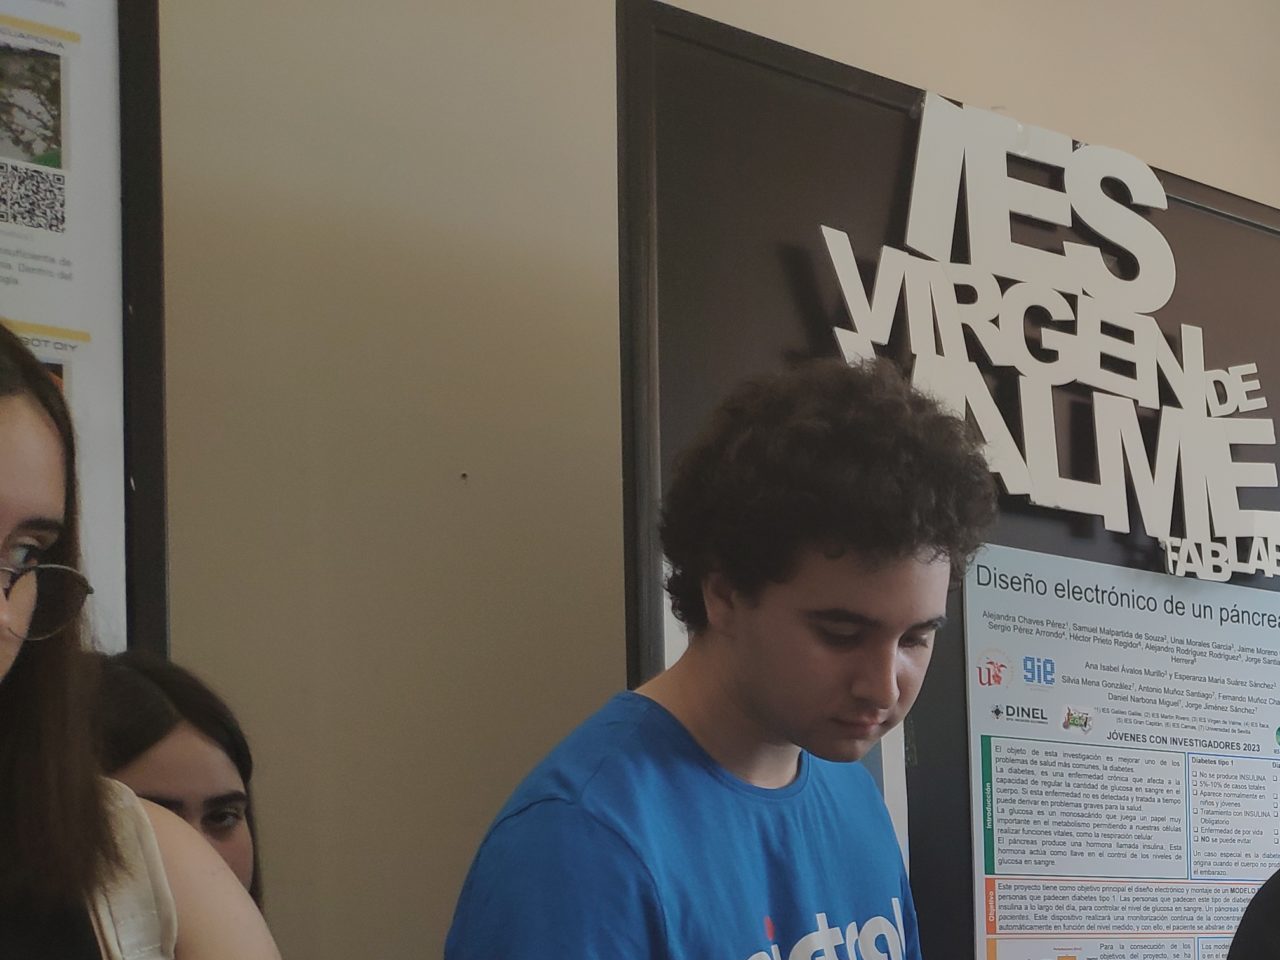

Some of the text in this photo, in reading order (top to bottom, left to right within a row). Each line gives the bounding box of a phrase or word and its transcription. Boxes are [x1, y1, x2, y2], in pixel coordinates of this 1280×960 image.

[904, 91, 1177, 314] IES
[820, 224, 1269, 418] VIRGEN DE
[53, 341, 79, 352] DIY
[976, 564, 1047, 596] Diseño
[1054, 579, 1158, 612] electrónico
[1163, 595, 1185, 616] de
[1191, 603, 1213, 620] un
[1005, 705, 1048, 721] DINEL
[1106, 730, 1260, 752] JÓVENES CON INVESTIGADORES 2023
[995, 756, 1028, 764] problemas
[1040, 759, 1056, 767] salud
[1058, 760, 1070, 768] más
[1102, 763, 1108, 771] la
[1006, 747, 1026, 756] objeto
[1062, 751, 1102, 761] investigación
[1118, 756, 1140, 764] mejorar
[1160, 758, 1167, 766] de
[1172, 759, 1180, 767] los
[1192, 757, 1217, 765] Diabetes
[1218, 759, 1230, 767] tipo
[1216, 772, 1238, 780] produce
[1239, 773, 1266, 782] INSULINA
[1200, 789, 1222, 798] Aparece
